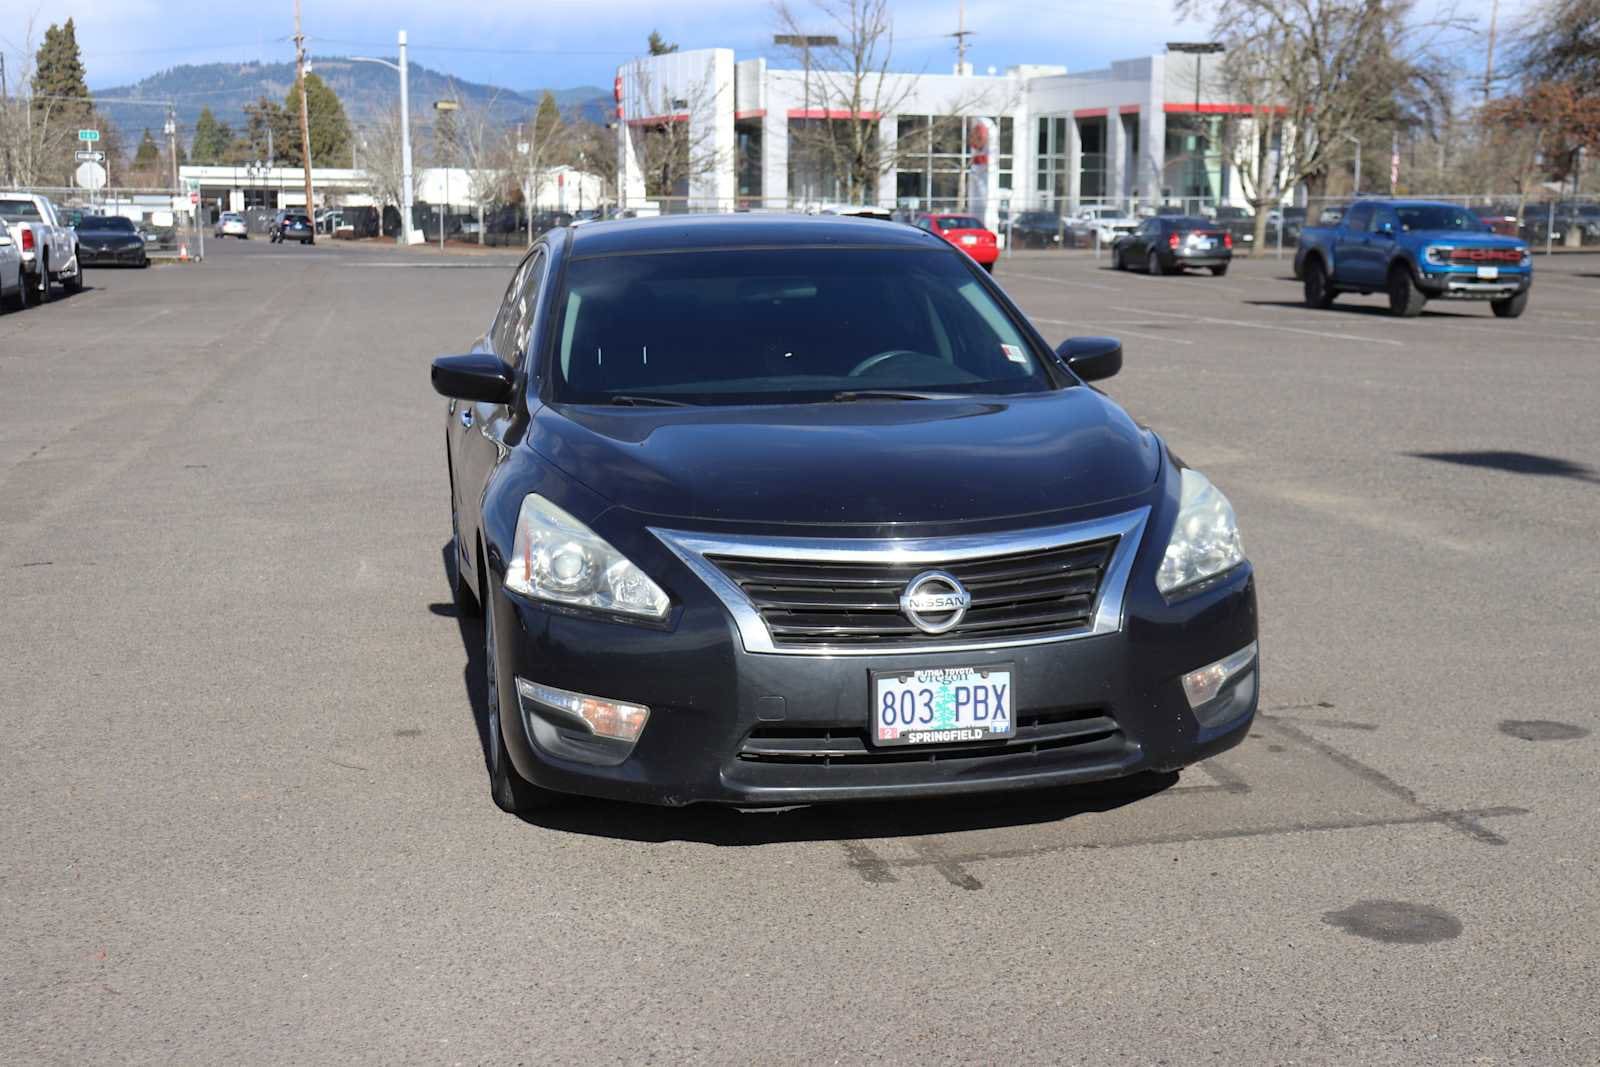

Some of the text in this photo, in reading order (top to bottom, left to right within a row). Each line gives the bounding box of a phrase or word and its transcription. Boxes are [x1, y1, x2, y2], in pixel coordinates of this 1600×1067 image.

[909, 597, 964, 608] NISSAN
[882, 684, 1007, 726] 803 PBX
[908, 728, 983, 743] SPRINGFIELD
